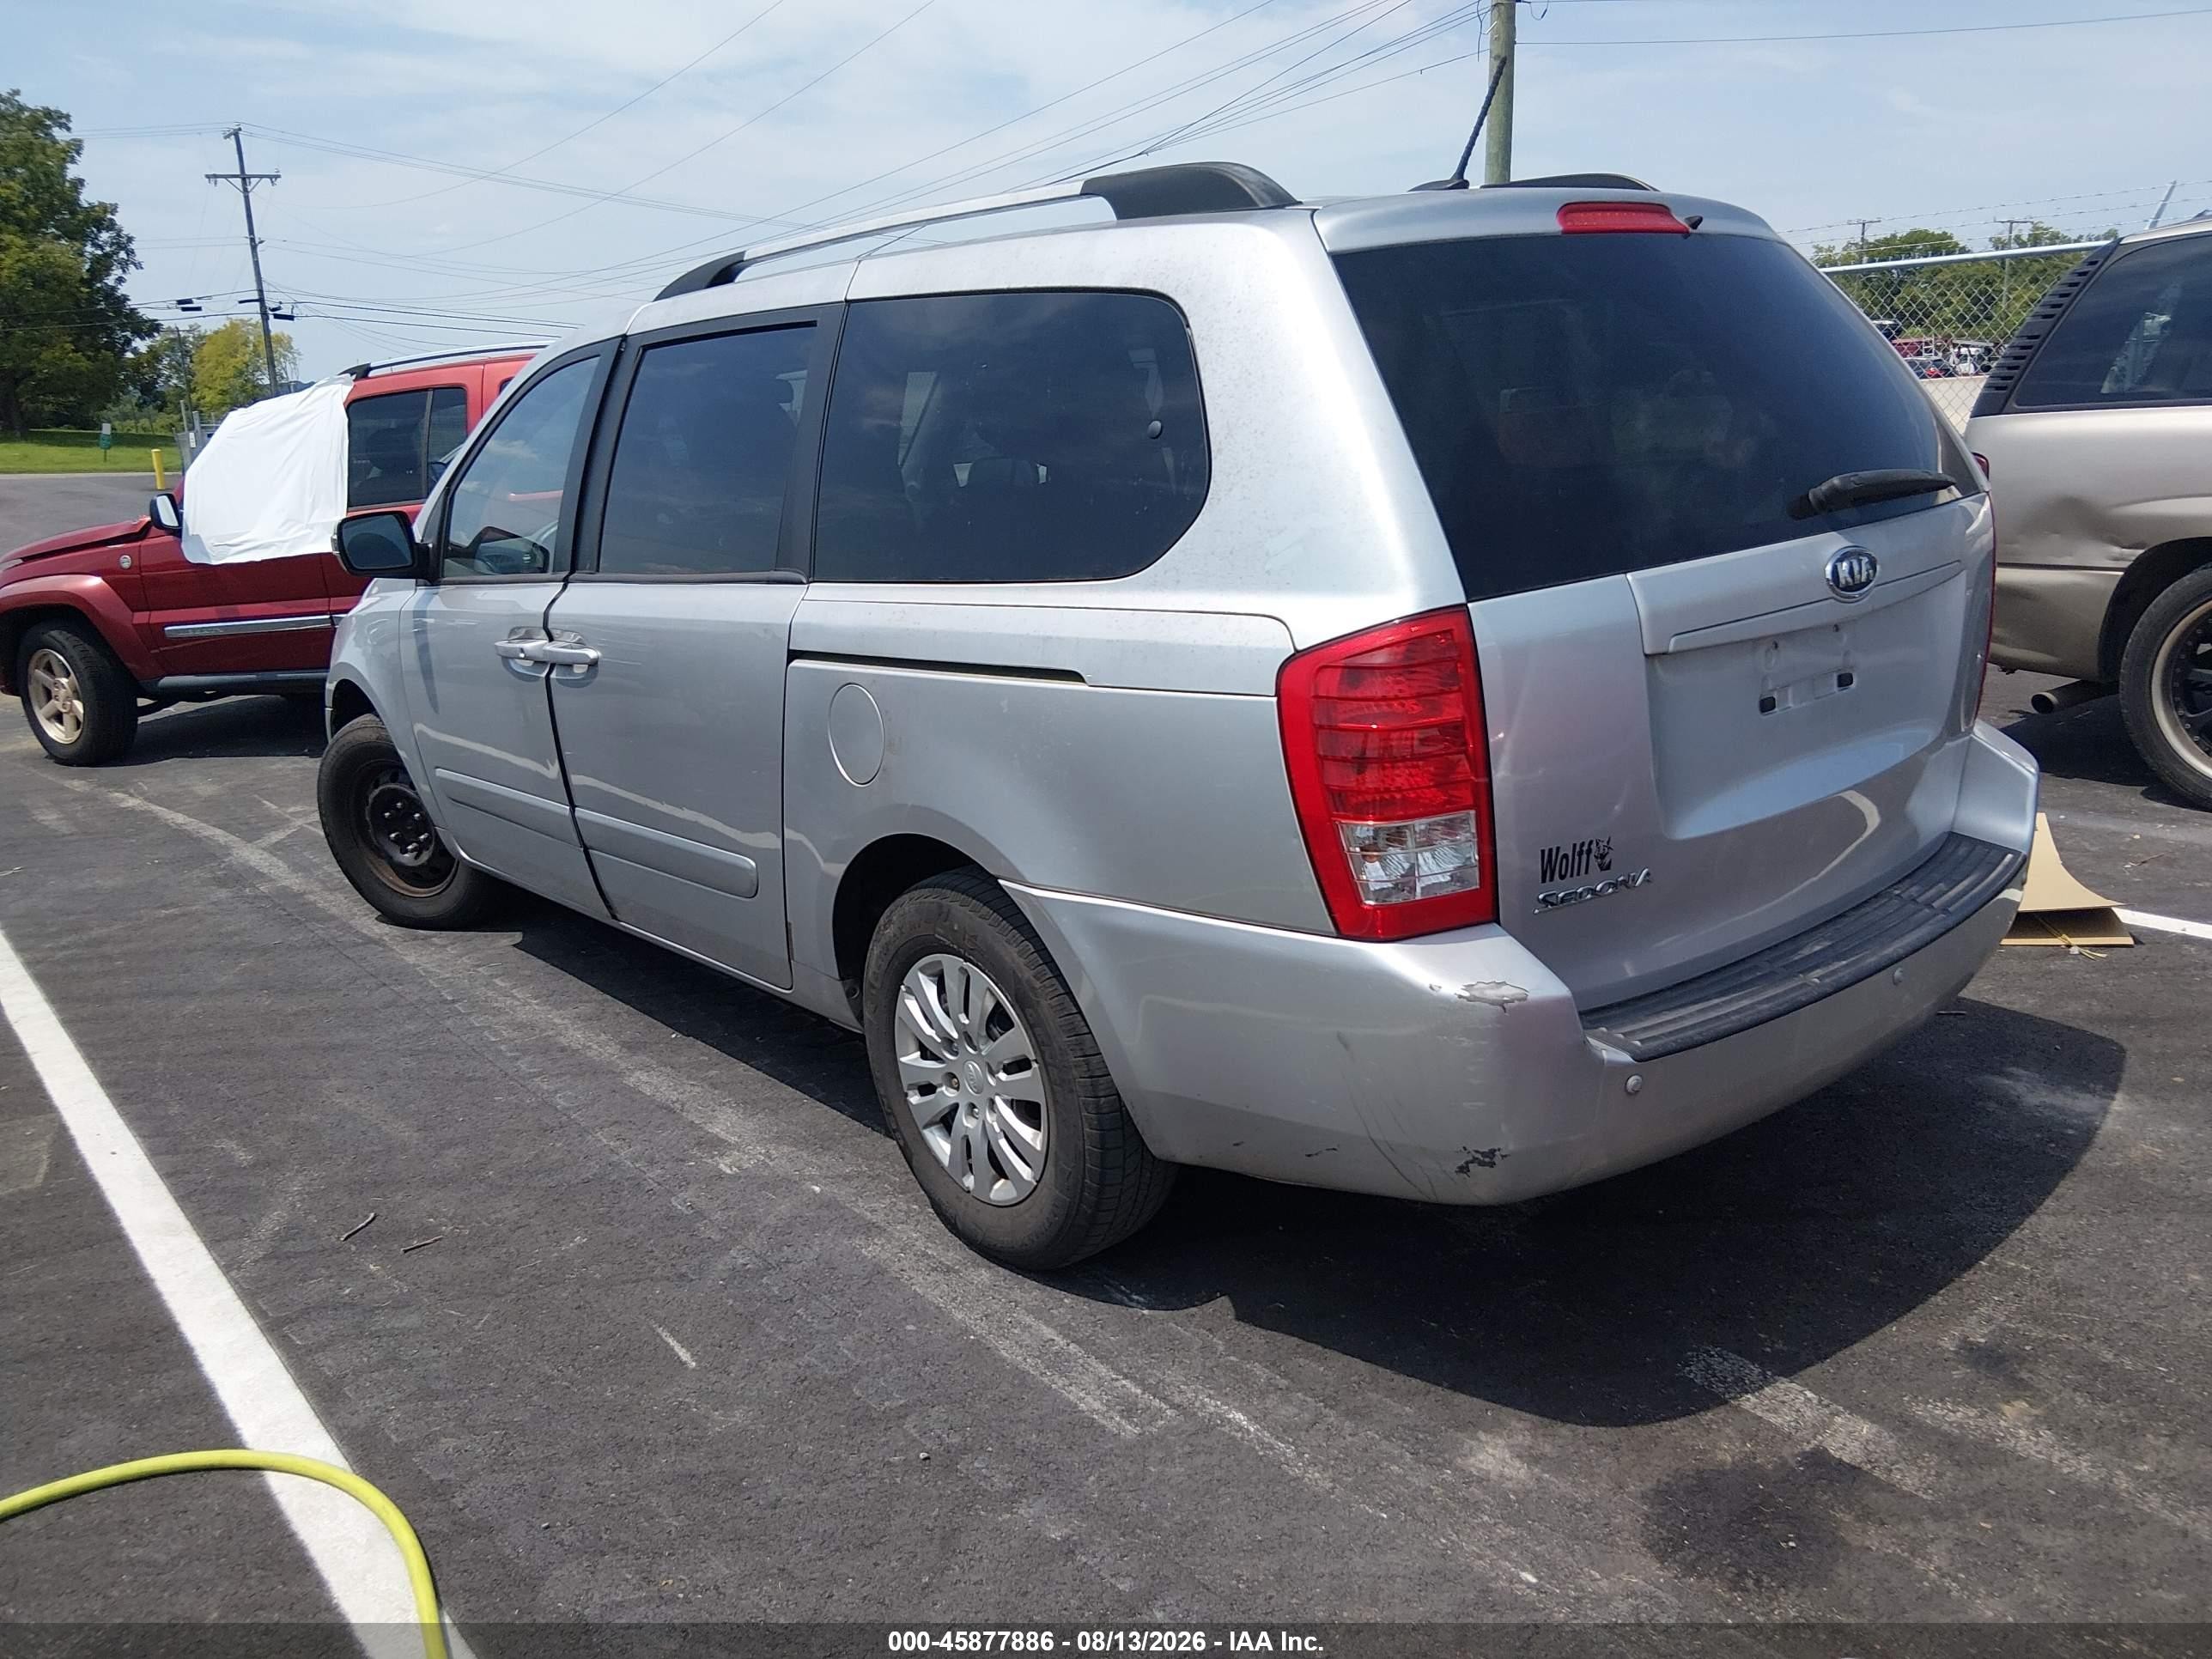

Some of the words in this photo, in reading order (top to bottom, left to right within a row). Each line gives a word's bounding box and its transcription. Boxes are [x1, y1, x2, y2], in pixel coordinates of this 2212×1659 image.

[1835, 556, 1875, 588] KIA
[1539, 838, 1595, 884] Wolff
[1536, 866, 1653, 909] SEDONA
